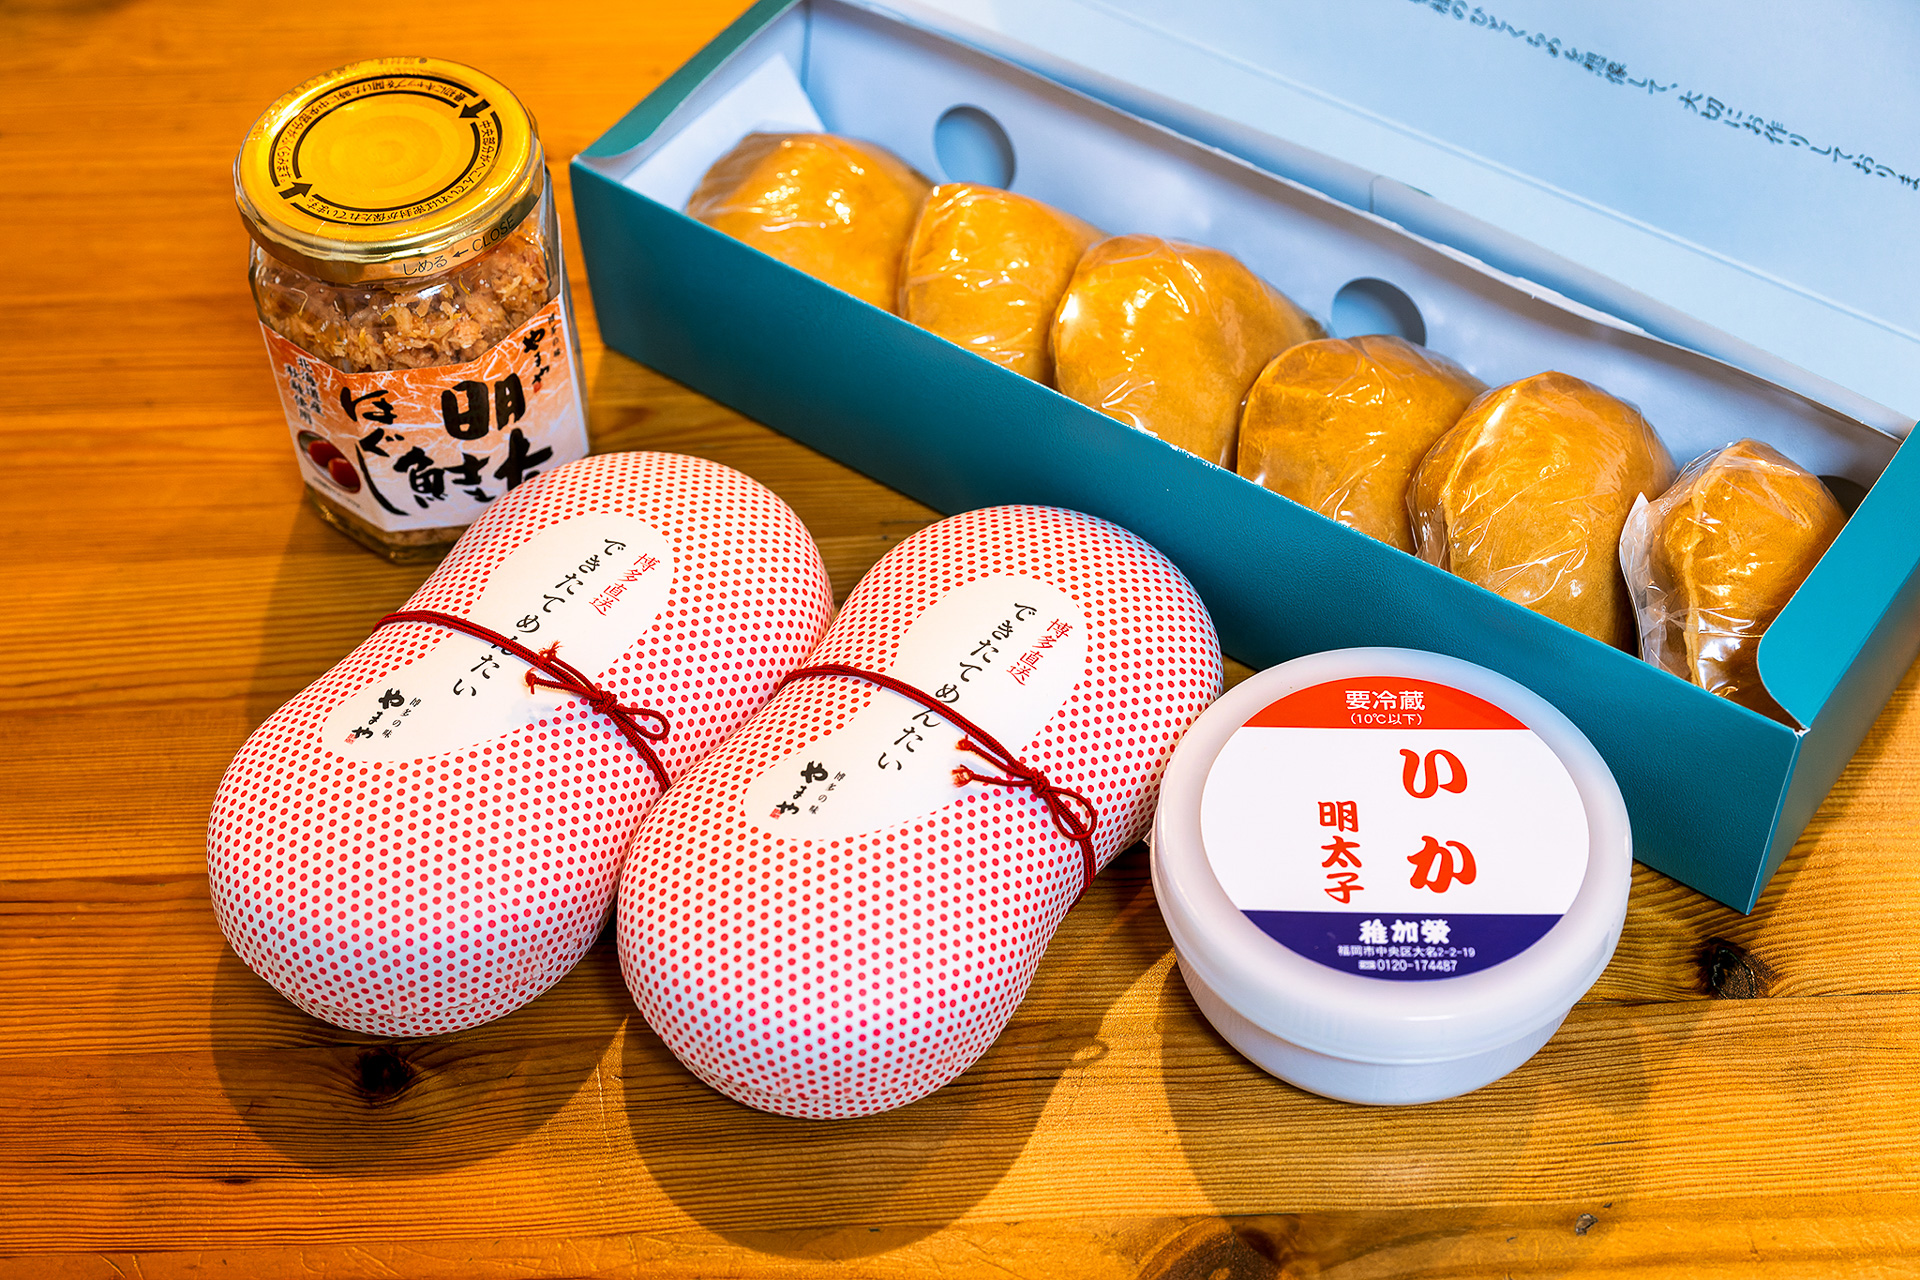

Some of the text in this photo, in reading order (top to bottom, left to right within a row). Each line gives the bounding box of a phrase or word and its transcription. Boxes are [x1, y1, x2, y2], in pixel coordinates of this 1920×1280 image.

[403, 214, 516, 276] しめる CLOSE
[589, 552, 661, 617] 博多直送
[1006, 618, 1073, 687] 博多直送
[877, 602, 1037, 772] できたてめんたい
[1344, 689, 1426, 711] 要冷蔵
[1350, 712, 1423, 726] (10℃以下)
[1317, 800, 1365, 904] 明太子
[1399, 747, 1478, 894] いか
[1376, 959, 1458, 973] 0120-174487
